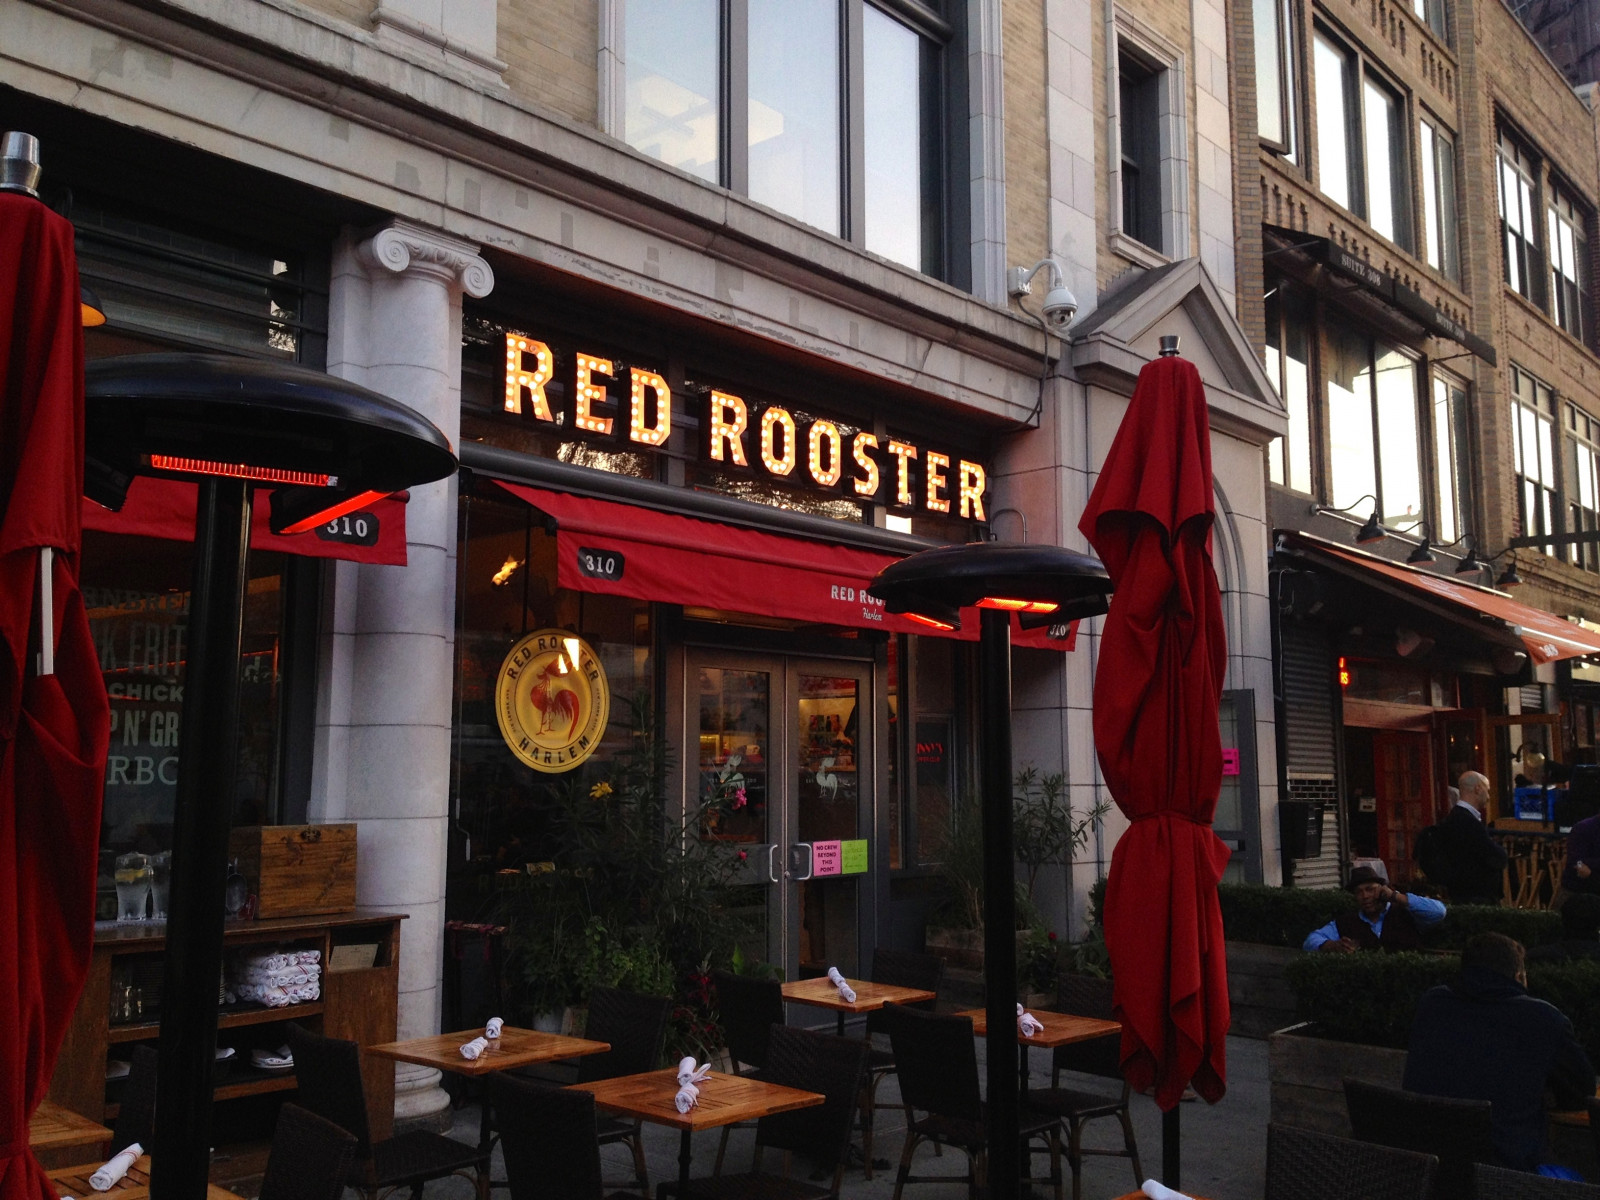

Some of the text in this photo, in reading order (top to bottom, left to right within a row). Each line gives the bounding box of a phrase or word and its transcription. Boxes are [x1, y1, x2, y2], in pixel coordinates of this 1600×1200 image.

[1341, 253, 1365, 276] SUITE
[503, 332, 986, 521] RED ROOSTER
[326, 516, 368, 538] 310
[585, 554, 616, 575] 310
[831, 585, 855, 602] RED
[862, 607, 883, 621] Harlem
[1049, 624, 1066, 637] 310
[507, 636, 600, 682] RED ROTER
[518, 735, 591, 764] HARLEM
